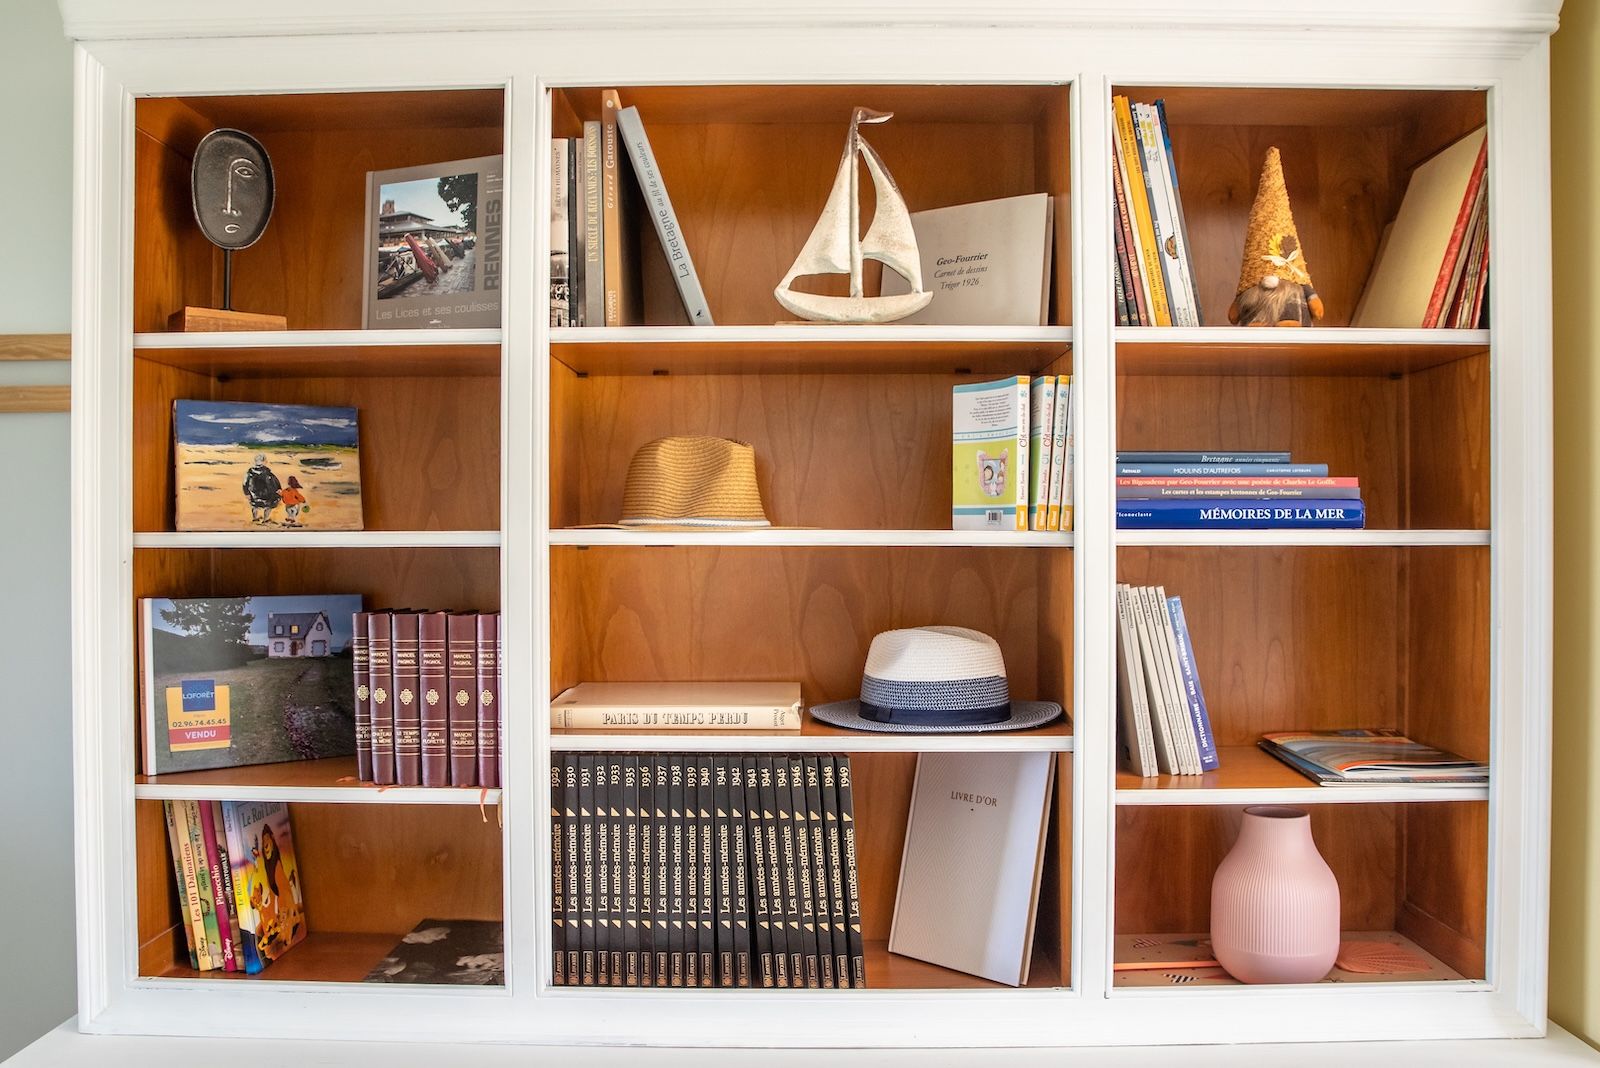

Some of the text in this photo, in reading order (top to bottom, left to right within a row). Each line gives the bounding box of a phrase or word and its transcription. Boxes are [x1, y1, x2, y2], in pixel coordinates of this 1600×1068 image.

[606, 124, 614, 168] Garouste
[636, 141, 651, 169] couleurs
[647, 170, 655, 179] ses
[648, 179, 658, 189] de
[657, 197, 665, 207] au
[588, 215, 597, 224] DE
[484, 199, 500, 290] RENNES
[658, 209, 684, 261] Bretagne
[937, 253, 988, 266] Geo-Fourrier
[676, 263, 689, 279] La
[934, 266, 988, 278] Carnet de dessins
[376, 302, 498, 320] Les Lices et ses coulisses
[1201, 455, 1233, 463] Bretagne
[1200, 507, 1344, 520] MÉMOIRES DE LA MER
[603, 713, 748, 725] PARIS DU TEMPS PERDU
[185, 730, 216, 739] VENDU
[552, 767, 560, 787] 1929
[567, 767, 576, 787] 1930
[582, 769, 590, 787] 1931
[597, 766, 606, 785] 1932
[611, 764, 619, 784] 1933
[626, 766, 635, 787] 1935
[641, 766, 651, 787] 1936
[657, 766, 666, 785] 1937
[671, 766, 681, 785] 1938
[687, 767, 696, 787] 1939
[701, 768, 710, 785] 1940
[717, 767, 725, 785] 1941
[732, 768, 740, 786] 1942
[748, 769, 757, 787] 1943
[761, 768, 770, 787] 1944
[777, 768, 787, 787] 1945
[792, 766, 802, 787] 1946
[807, 766, 817, 787] 1947
[824, 766, 833, 787] 1948
[840, 767, 849, 787] 1949
[951, 791, 997, 807] LIVRE D'OR
[241, 812, 251, 827] Le
[252, 805, 264, 823] Roi
[552, 823, 563, 912] Les années-mémoire
[567, 824, 577, 912] Les années-mémoire
[582, 824, 592, 912] Les années-mémoire
[597, 823, 607, 912] Les années-mémoire
[611, 824, 621, 912] Les années-mémoire
[626, 823, 636, 912] Les années-mémoire
[641, 825, 651, 913] Les années-mémoire
[657, 825, 667, 913] Les années-mémoire
[671, 825, 681, 913] Les années-mémoire
[686, 825, 696, 913] Les années-mémoire
[701, 825, 711, 913] Les années-mémoire
[718, 825, 730, 913] Les années-mémoire
[733, 825, 746, 913] Les années-mémoire
[752, 825, 768, 915] Les années-mémoire
[767, 825, 782, 915] Les années-mémoire
[782, 825, 798, 914] Les années-mémoire
[797, 827, 813, 916] Les années-mémoire
[813, 826, 827, 916] Les années-mémoire
[829, 828, 844, 916] Les années-mémoire
[844, 828, 859, 917] Les années-mémoire
[184, 843, 202, 922] Les 101 Dalmatiens
[212, 864, 224, 906] Pinocchio
[223, 938, 235, 962] Disney
